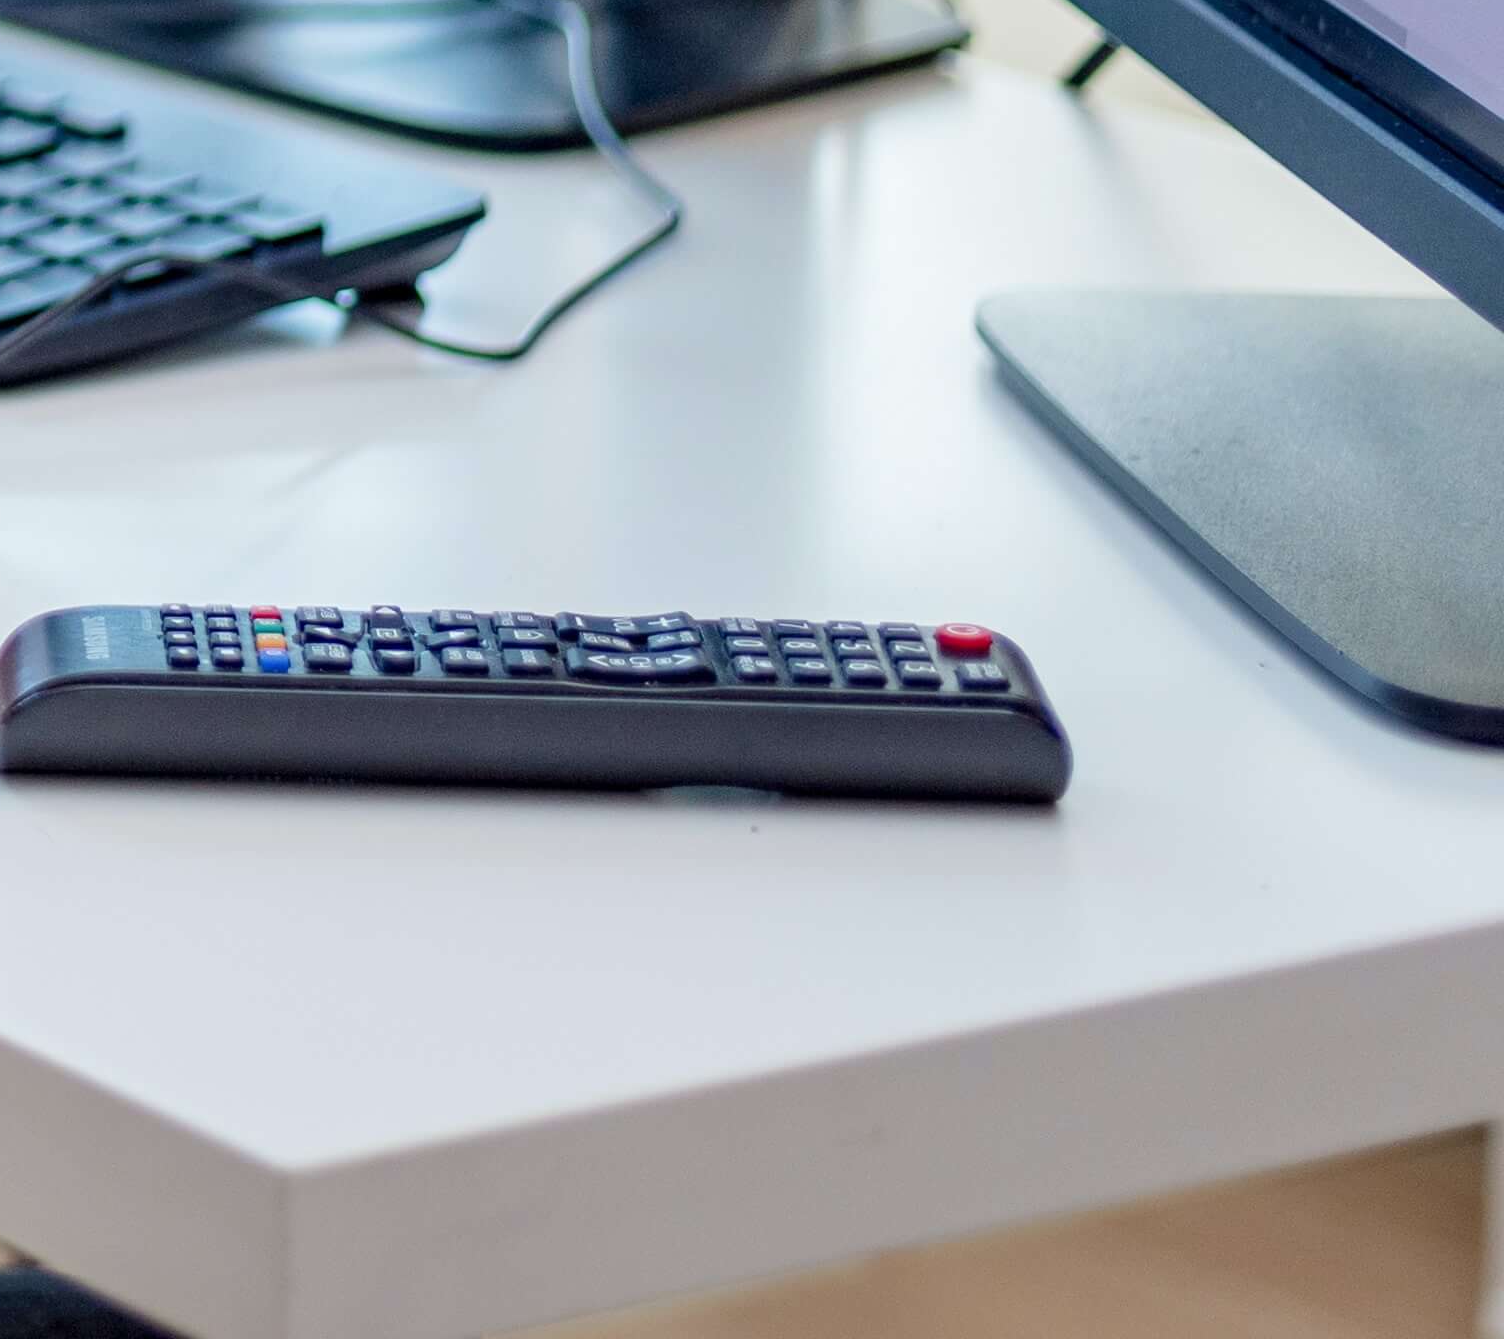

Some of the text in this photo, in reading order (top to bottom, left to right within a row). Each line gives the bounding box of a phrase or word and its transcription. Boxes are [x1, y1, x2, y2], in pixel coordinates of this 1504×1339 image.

[612, 617, 635, 634] VOL
[81, 615, 110, 660] SAMSUNG
[733, 639, 764, 647] 0
[786, 641, 816, 649] 8
[840, 642, 873, 651] 5
[895, 644, 925, 652] 2
[629, 656, 652, 668] CH
[794, 661, 825, 669] 9
[848, 661, 880, 670] 6
[904, 664, 935, 673] 3
